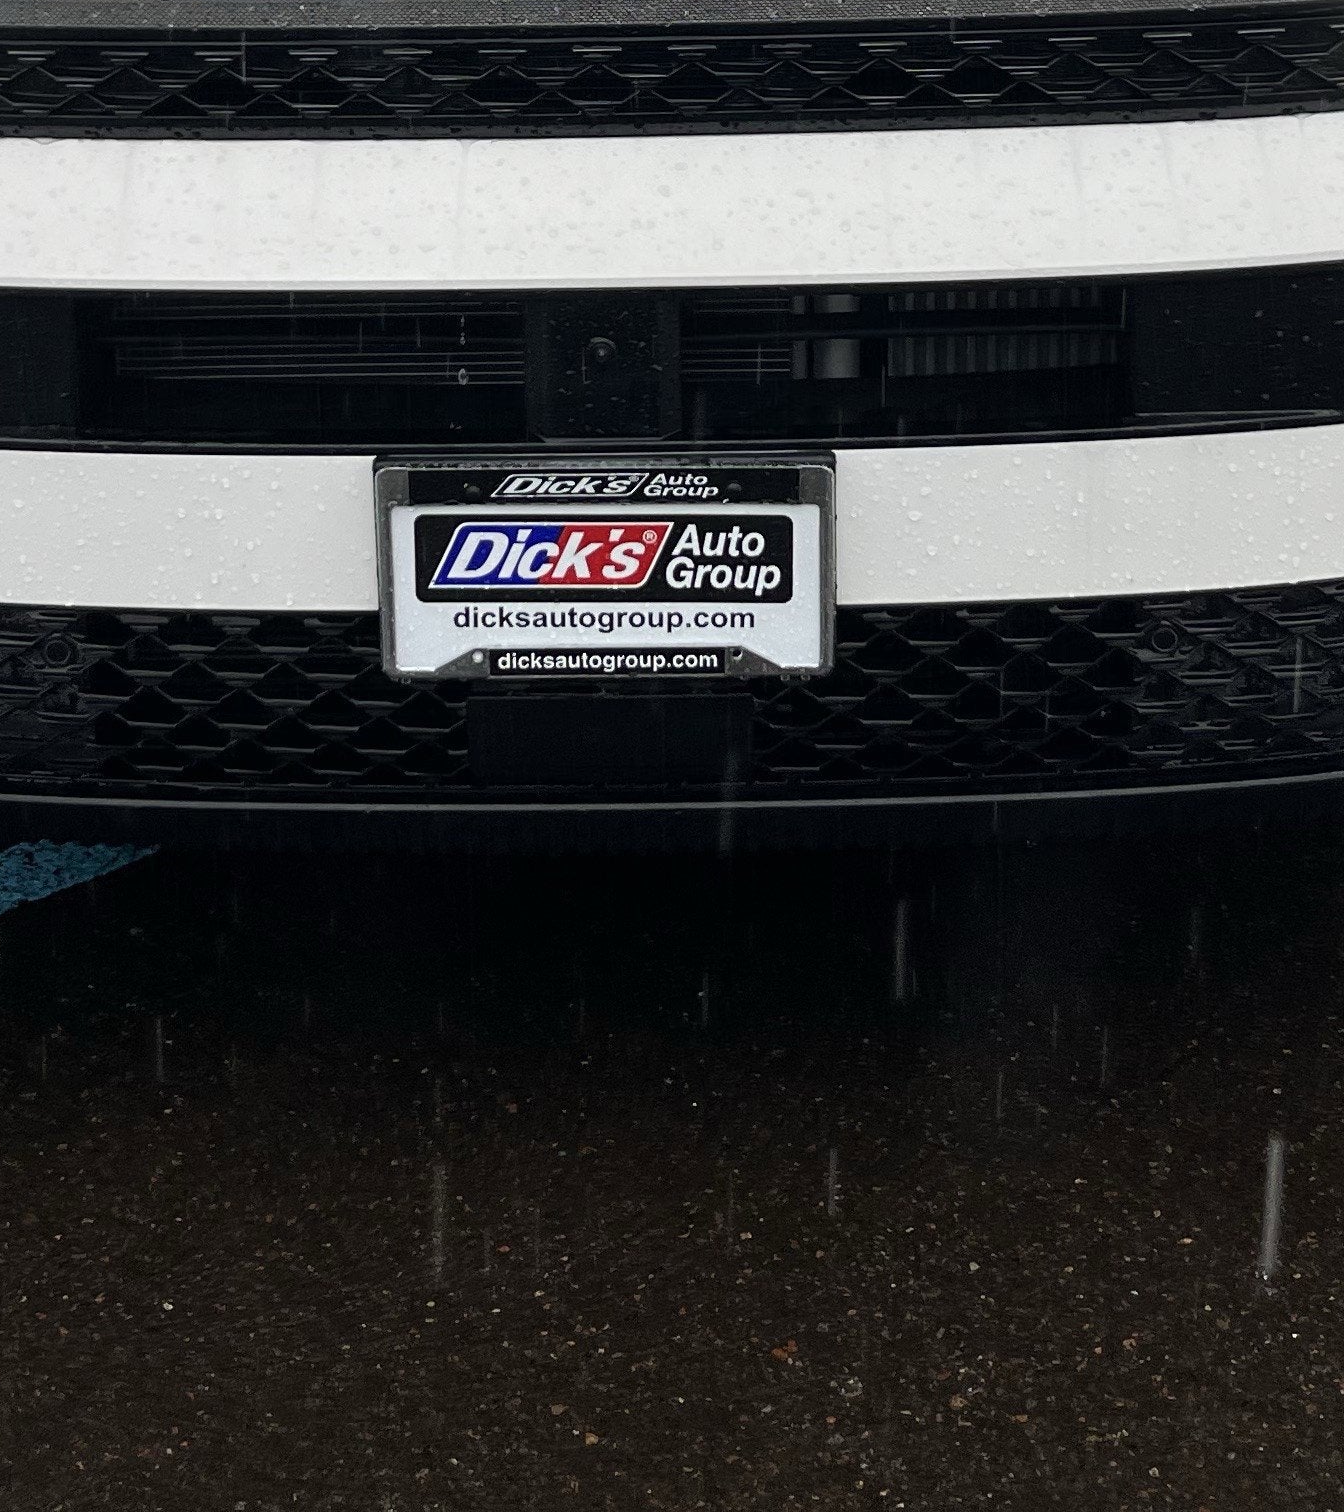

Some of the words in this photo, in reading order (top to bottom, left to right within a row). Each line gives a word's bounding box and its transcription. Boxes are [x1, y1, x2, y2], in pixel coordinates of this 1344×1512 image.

[503, 476, 630, 495] Dick's
[650, 473, 709, 486] Auto
[643, 485, 719, 498] Group
[446, 528, 646, 580] Dick's
[672, 523, 765, 559] Auto
[665, 557, 781, 596] Group
[453, 607, 756, 633] dicksautogroup.com
[497, 651, 719, 671] dicksautogroup.com
